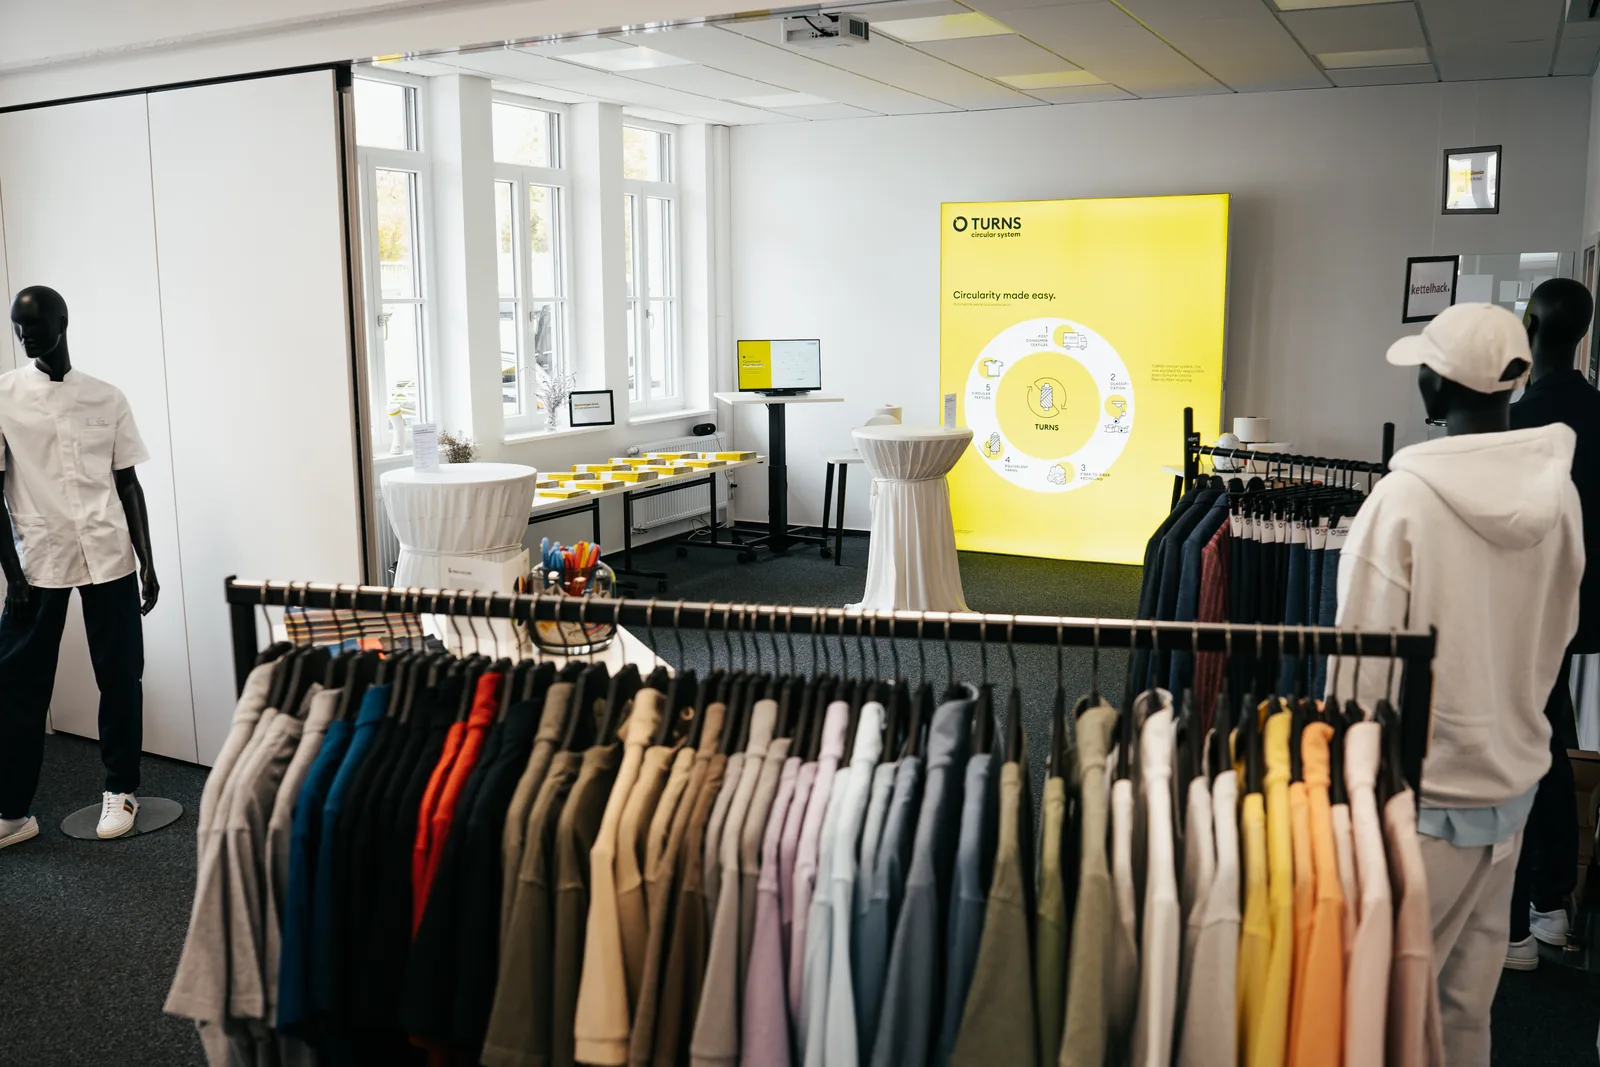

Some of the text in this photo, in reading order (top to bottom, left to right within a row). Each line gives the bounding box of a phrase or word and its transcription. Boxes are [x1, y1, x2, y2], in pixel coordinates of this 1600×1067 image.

[971, 217, 1022, 230] TURNS
[997, 231, 1021, 239] system
[1411, 283, 1450, 295] kettelhack.
[953, 290, 1056, 302] Circularity made easy.
[1110, 373, 1116, 381] 2
[985, 383, 991, 391] 5
[1035, 423, 1060, 431] TURNS
[1080, 463, 1086, 472] 3
